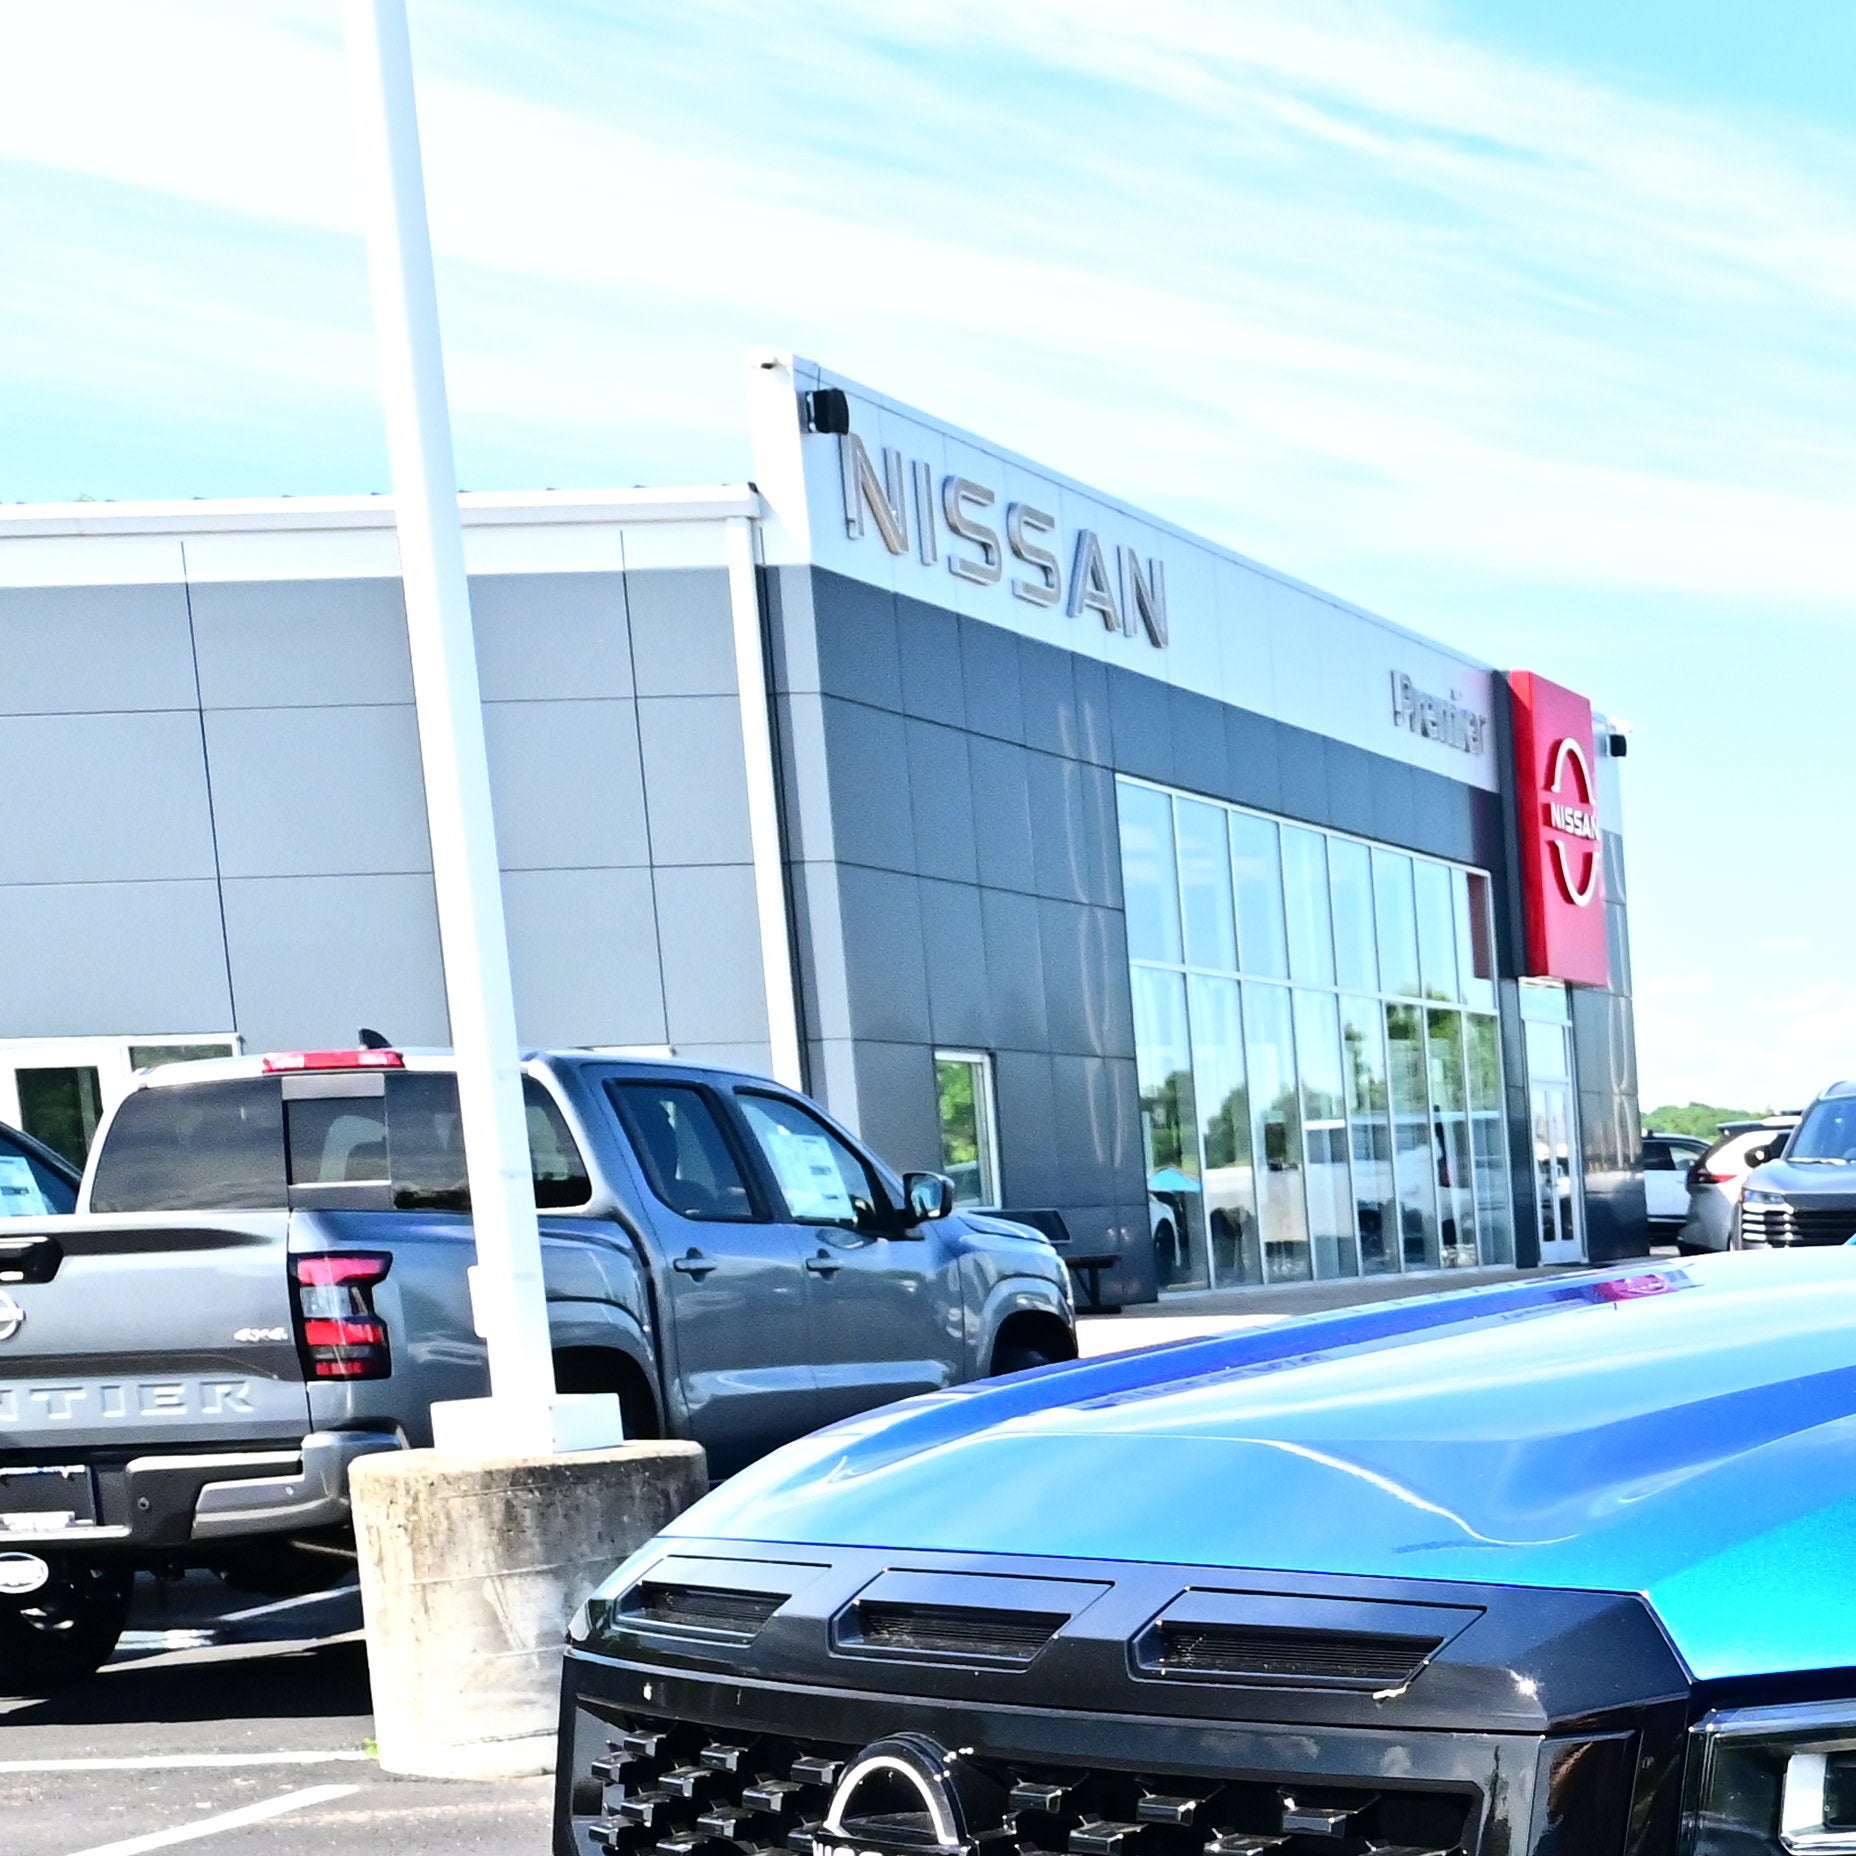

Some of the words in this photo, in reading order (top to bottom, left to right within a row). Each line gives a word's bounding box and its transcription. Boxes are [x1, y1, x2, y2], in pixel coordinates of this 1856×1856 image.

[839, 430, 1168, 648] NISSAN
[1390, 670, 1486, 757] Premier
[1550, 801, 1600, 841] NISSAN
